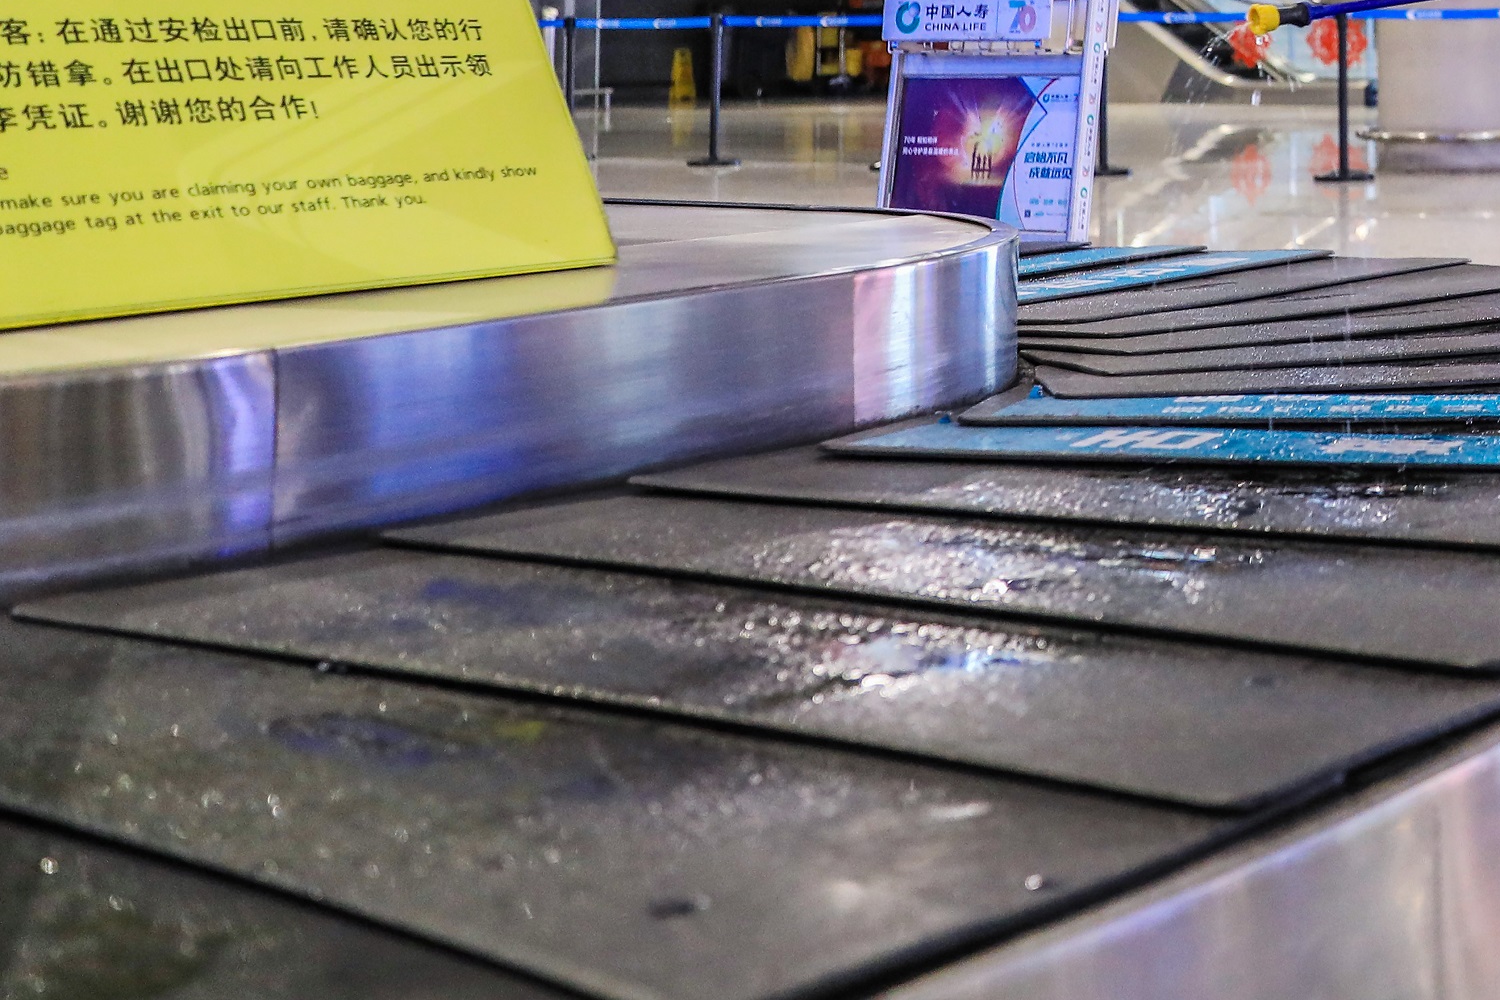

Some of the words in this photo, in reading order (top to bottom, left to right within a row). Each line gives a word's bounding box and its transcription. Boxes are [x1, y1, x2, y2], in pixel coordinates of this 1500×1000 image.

[925, 3, 989, 19] 中国人寿
[925, 22, 959, 32] CHINA
[962, 22, 988, 31] LIFE
[0, 193, 53, 211] make
[61, 191, 101, 206] sure
[108, 190, 144, 207] you
[152, 186, 180, 200] are
[187, 181, 257, 197] claiming
[261, 179, 299, 195] your
[306, 177, 342, 190] own
[347, 173, 418, 189] baggage,
[423, 169, 450, 184] and
[453, 166, 495, 182] kindly
[500, 164, 538, 179] show
[85, 214, 118, 231] tag
[125, 212, 145, 226] at
[152, 209, 183, 223] the
[190, 205, 224, 221] exit
[231, 204, 251, 218] to
[257, 201, 284, 216] our
[291, 197, 336, 213] staff.
[341, 193, 388, 209] Thank
[394, 193, 428, 209] you.
